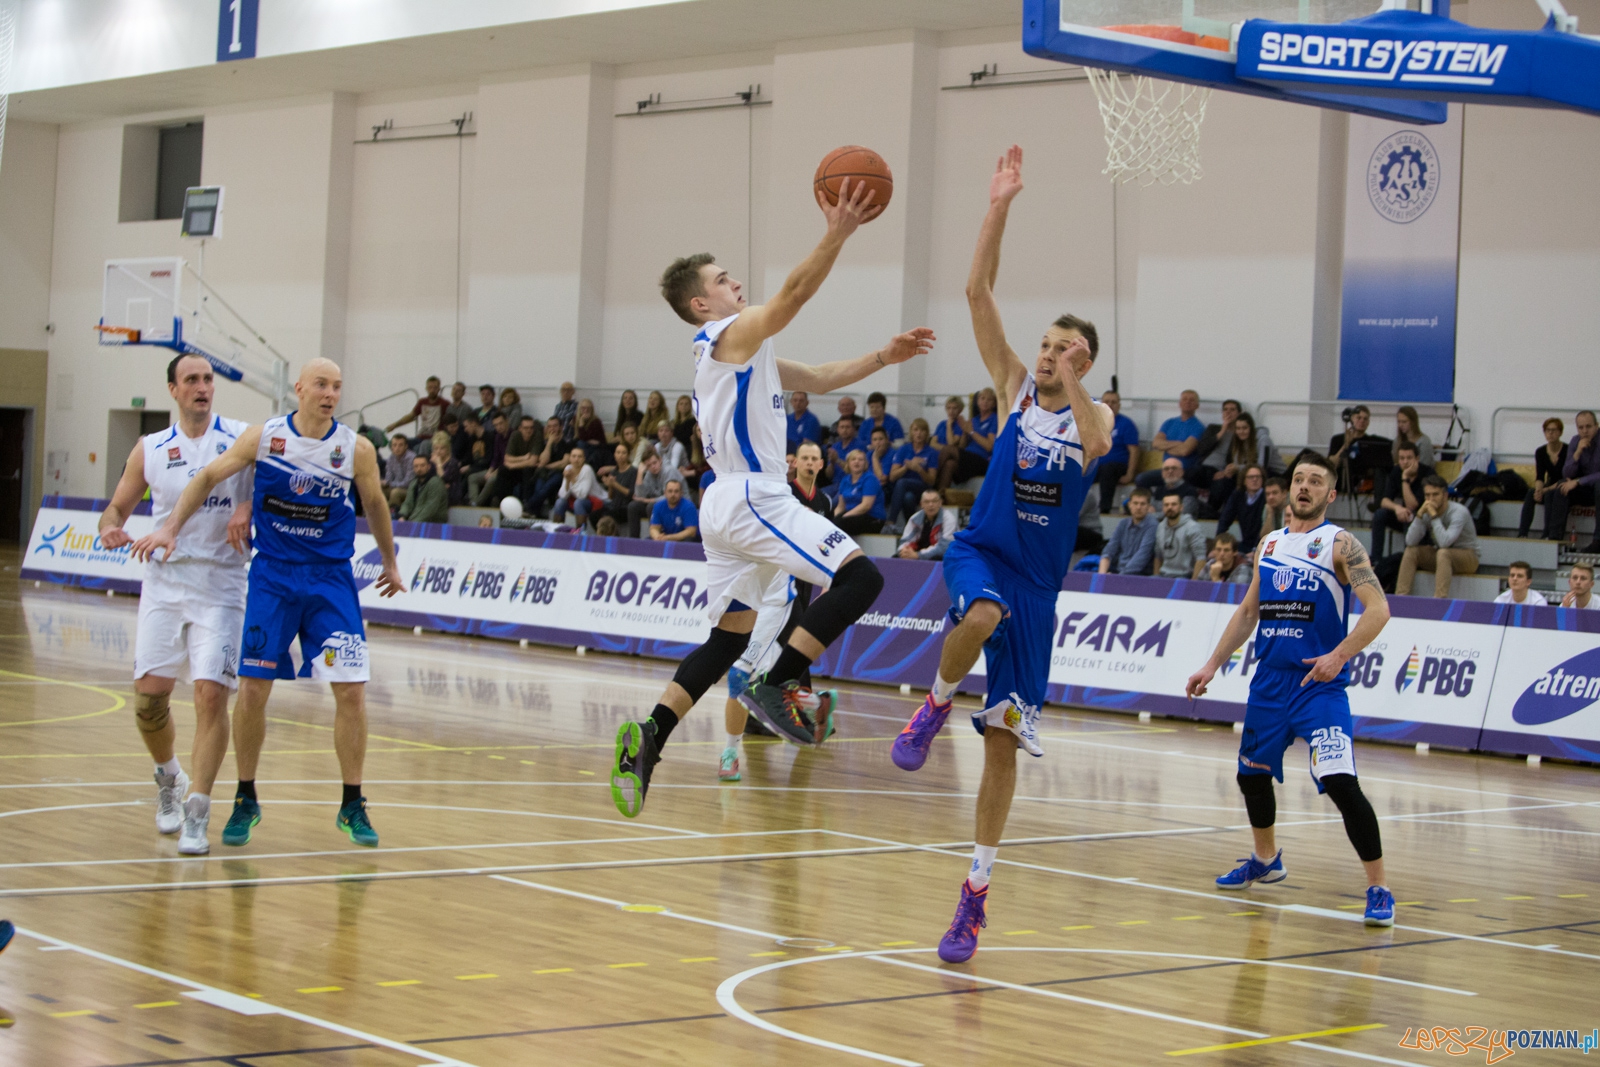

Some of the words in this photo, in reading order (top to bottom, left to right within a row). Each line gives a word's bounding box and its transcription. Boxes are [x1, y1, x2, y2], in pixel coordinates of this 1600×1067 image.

[228, 0, 242, 54] 1
[1259, 31, 1508, 81] SPORTSYSTEM
[1016, 509, 1049, 527] WIEC
[422, 566, 456, 595] PBG
[471, 571, 506, 600] PBG
[522, 575, 558, 605] PBG
[1296, 567, 1322, 592] 25
[621, 611, 670, 625] PRODUCENT
[1053, 611, 1173, 658] FARM
[1052, 656, 1103, 670] ODUCENT
[1425, 644, 1481, 659] fundacja
[1415, 656, 1477, 698] PBG
[1318, 725, 1346, 755] 25
